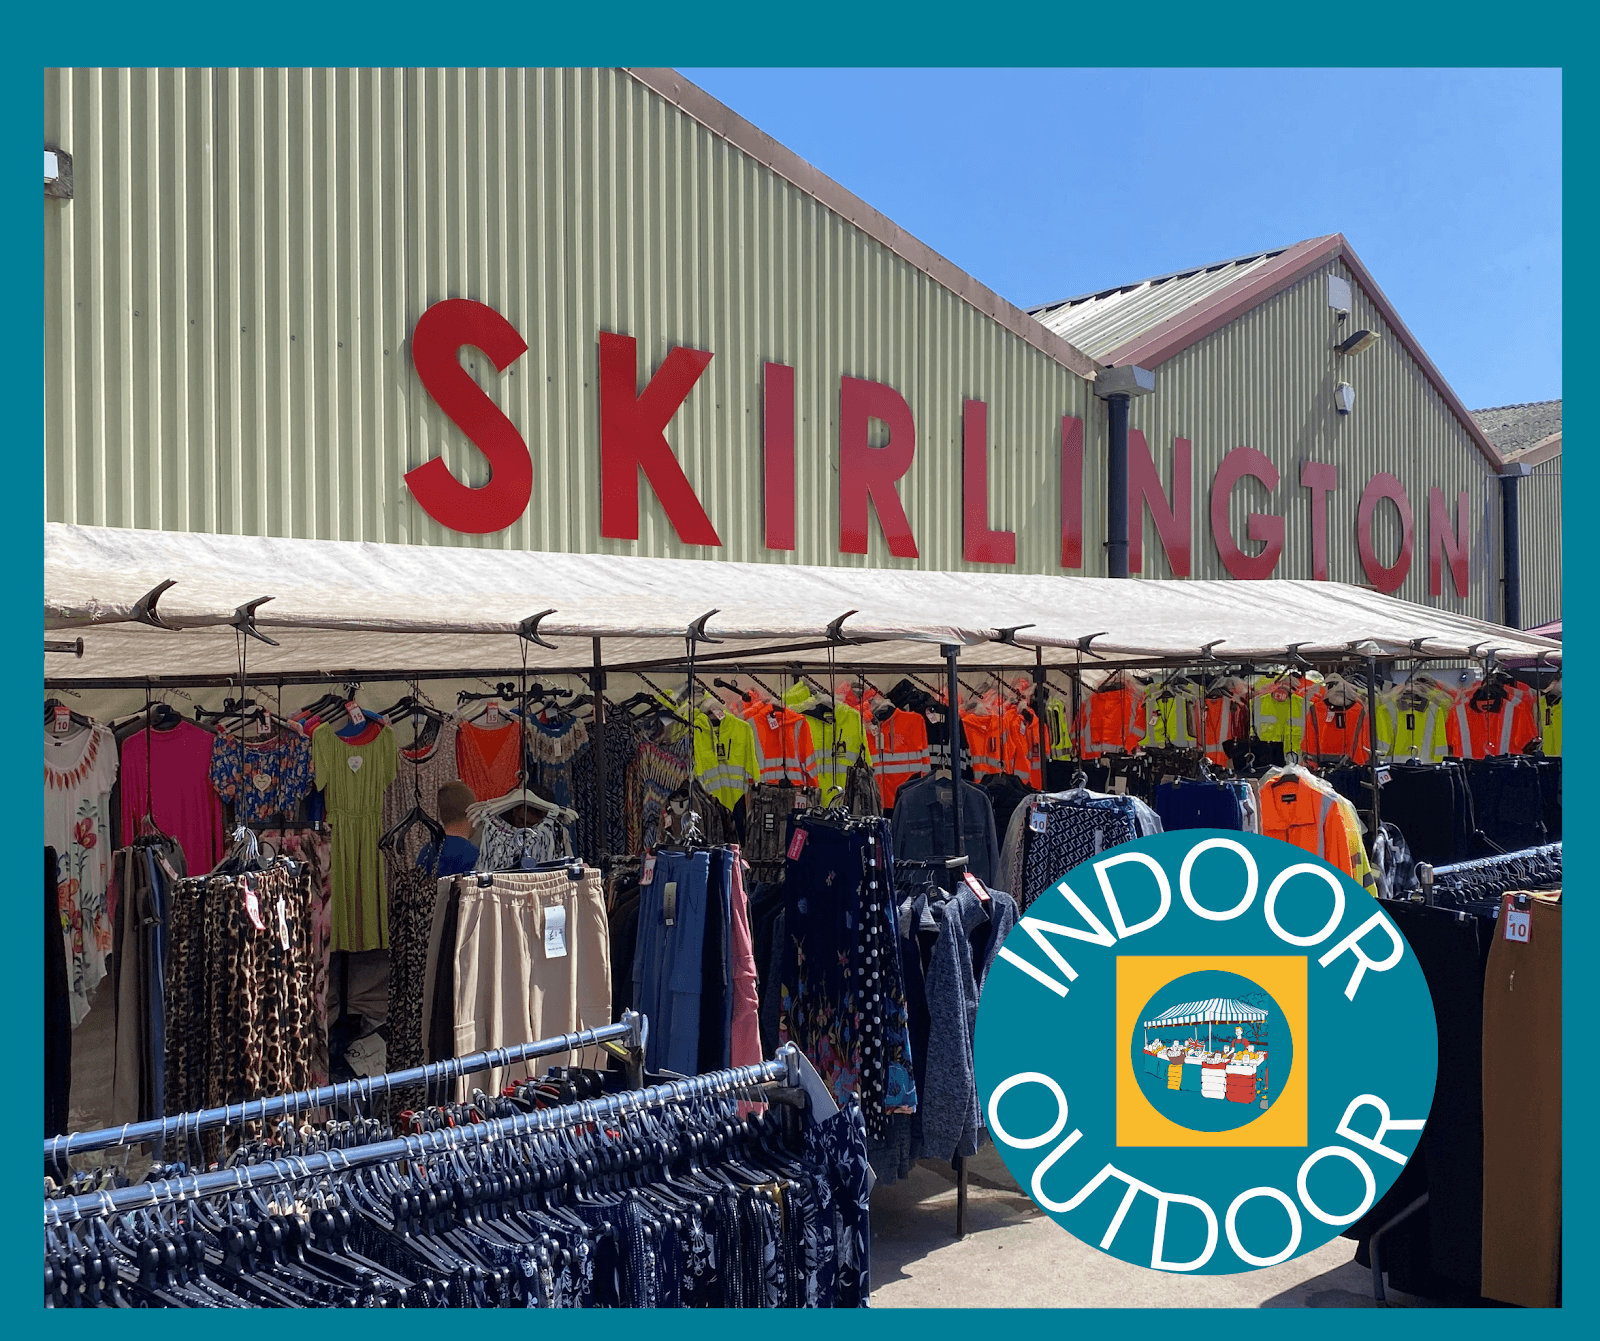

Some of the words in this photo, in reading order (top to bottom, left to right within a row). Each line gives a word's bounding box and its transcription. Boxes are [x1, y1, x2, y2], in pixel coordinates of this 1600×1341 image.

[404, 298, 1469, 598] SKIRLINGTON
[353, 713, 363, 722] 15
[57, 721, 68, 730] 10
[1379, 773, 1390, 782] 10
[1033, 819, 1045, 831] 10
[645, 868, 653, 882] 10
[1509, 922, 1527, 938] 10
